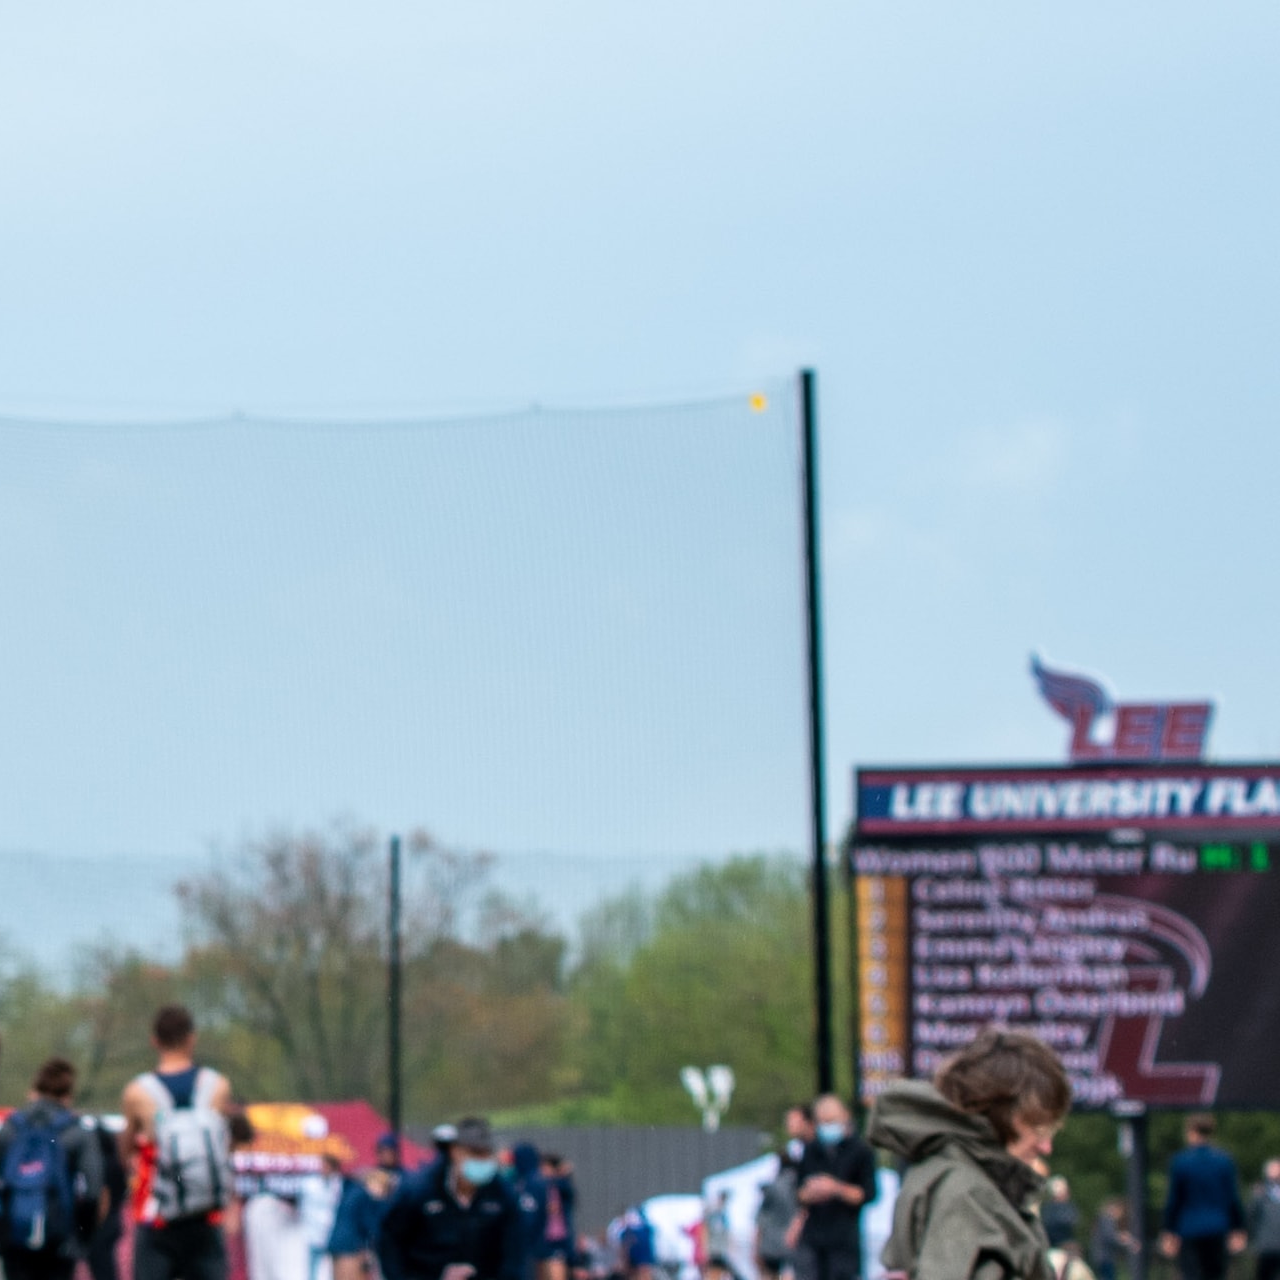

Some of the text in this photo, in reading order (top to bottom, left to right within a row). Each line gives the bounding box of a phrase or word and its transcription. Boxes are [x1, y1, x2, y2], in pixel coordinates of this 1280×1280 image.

[1066, 699, 1215, 762] LEE
[891, 782, 966, 819] LEE
[968, 778, 1206, 819] UNIVERSITY
